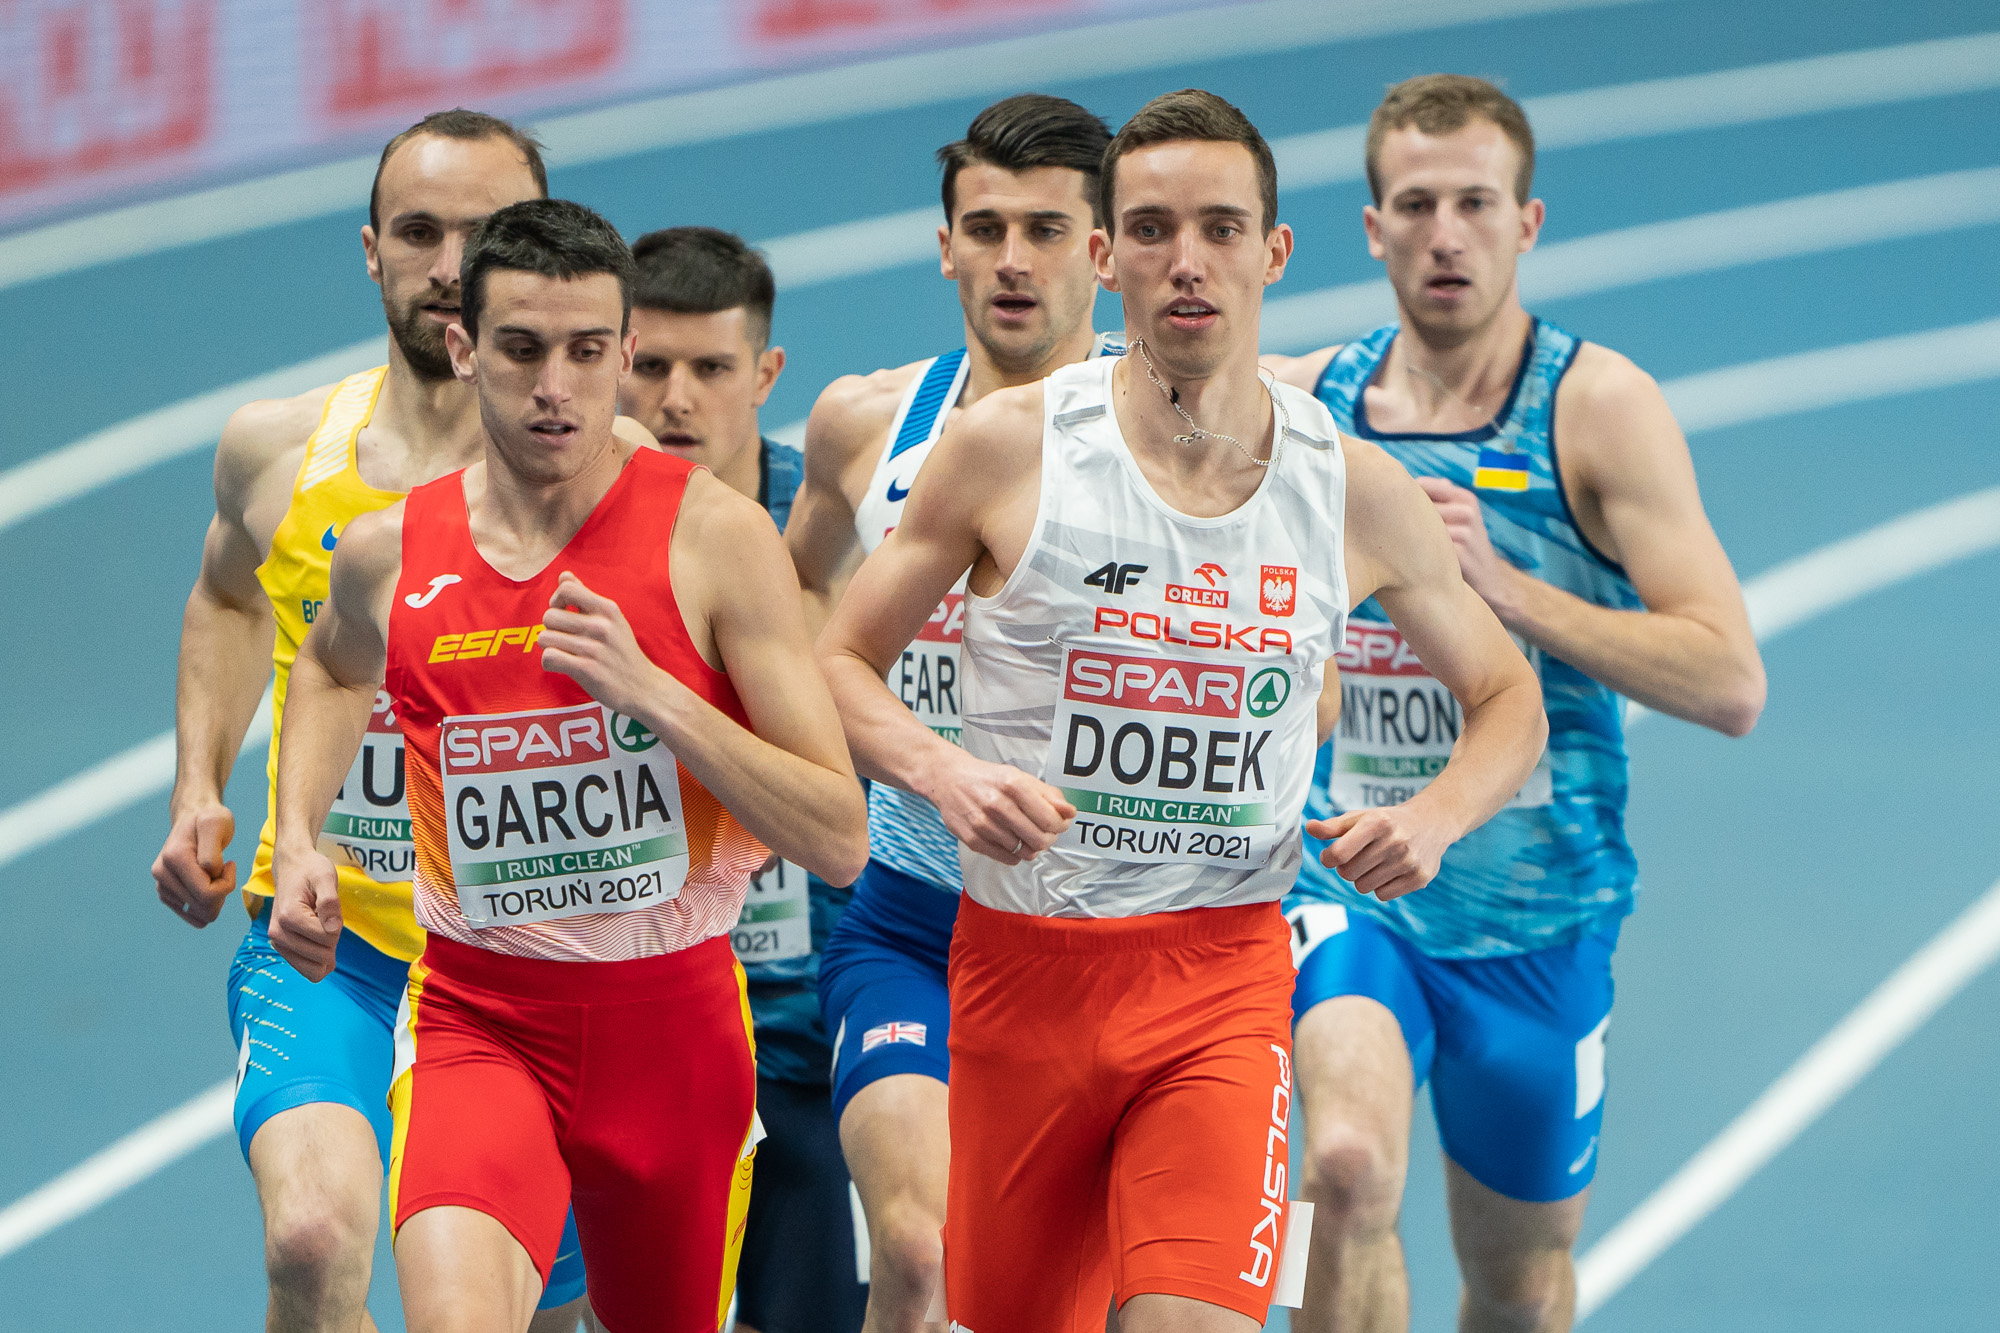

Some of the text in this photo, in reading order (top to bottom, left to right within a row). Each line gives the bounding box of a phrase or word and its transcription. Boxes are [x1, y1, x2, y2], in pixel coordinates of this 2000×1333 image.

[1084, 562, 1148, 594] 4F
[1263, 567, 1295, 576] POLSKA
[1168, 587, 1226, 606] ORLEN
[1094, 606, 1293, 655] POLSKA
[1070, 658, 1239, 711] SPAR
[446, 716, 604, 767] SPAR
[1063, 713, 1273, 793] DOBEK
[358, 818, 402, 838] RUN
[456, 763, 671, 850] GARCIA
[1108, 799, 1156, 818] RUN
[1075, 820, 1251, 860] TORUŃ 2021
[508, 858, 555, 880] RUN
[483, 870, 662, 917] TORUŃ 2021
[1239, 1043, 1291, 1288] POLSKA
